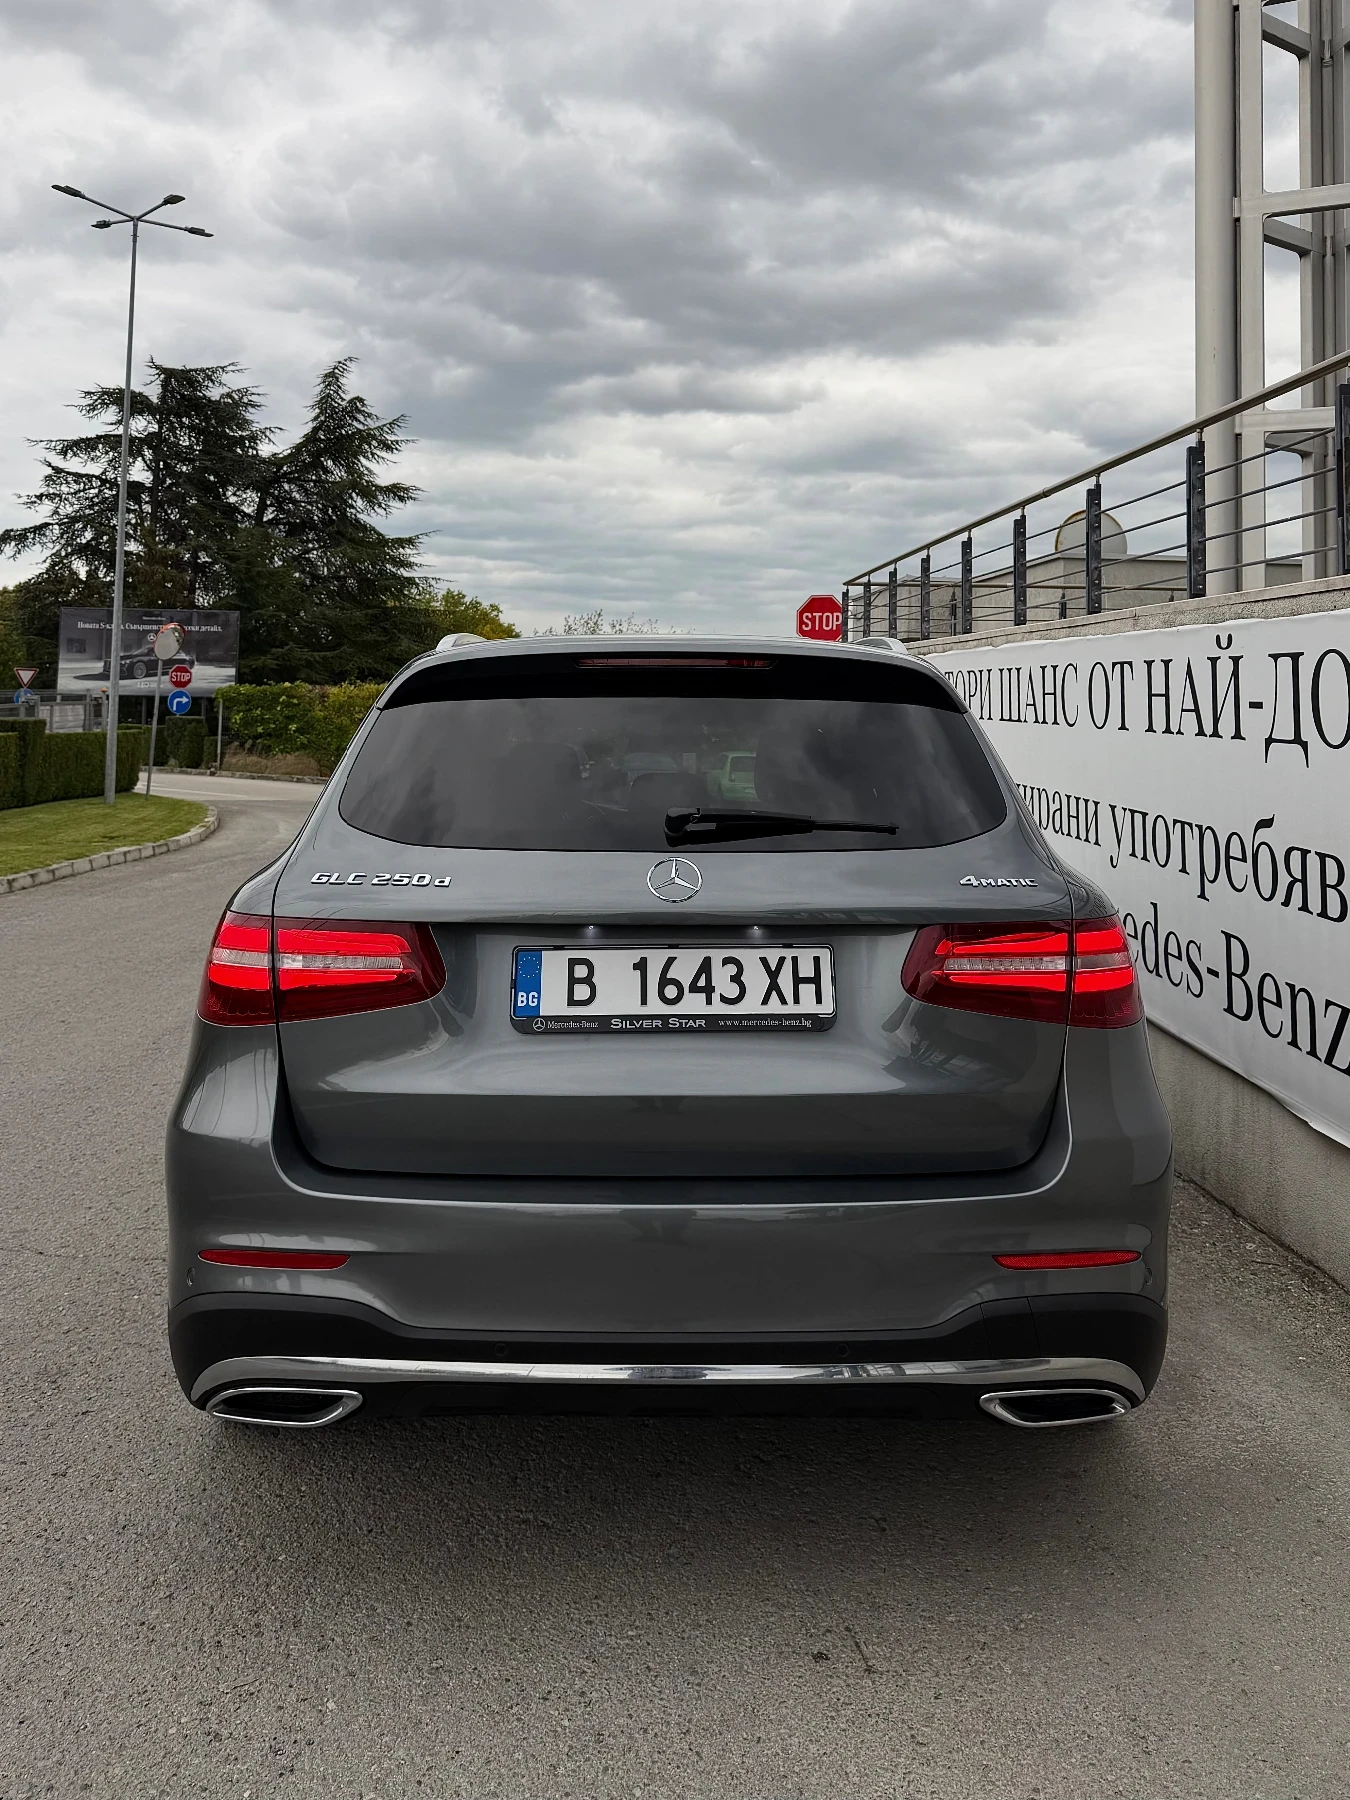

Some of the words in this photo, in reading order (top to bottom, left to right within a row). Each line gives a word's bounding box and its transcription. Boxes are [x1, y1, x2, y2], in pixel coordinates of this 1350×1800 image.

[802, 612, 842, 630] STOP
[171, 672, 191, 682] STOP
[998, 663, 1079, 728] ШАНС
[1087, 661, 1134, 731] ОТ
[1016, 783, 1101, 847] ирани
[1108, 803, 1349, 924] употребяв
[311, 872, 367, 885] GLC
[959, 875, 1039, 887] 4MATIC
[566, 957, 597, 1007] B
[632, 955, 747, 1006] 1643
[758, 955, 823, 1006] XH
[1120, 901, 1350, 1076] edes-Benz
[517, 991, 539, 1007] BG
[547, 1021, 599, 1029] Mercedes-Benz
[718, 1017, 812, 1028] www.mercedes-benz.bg
